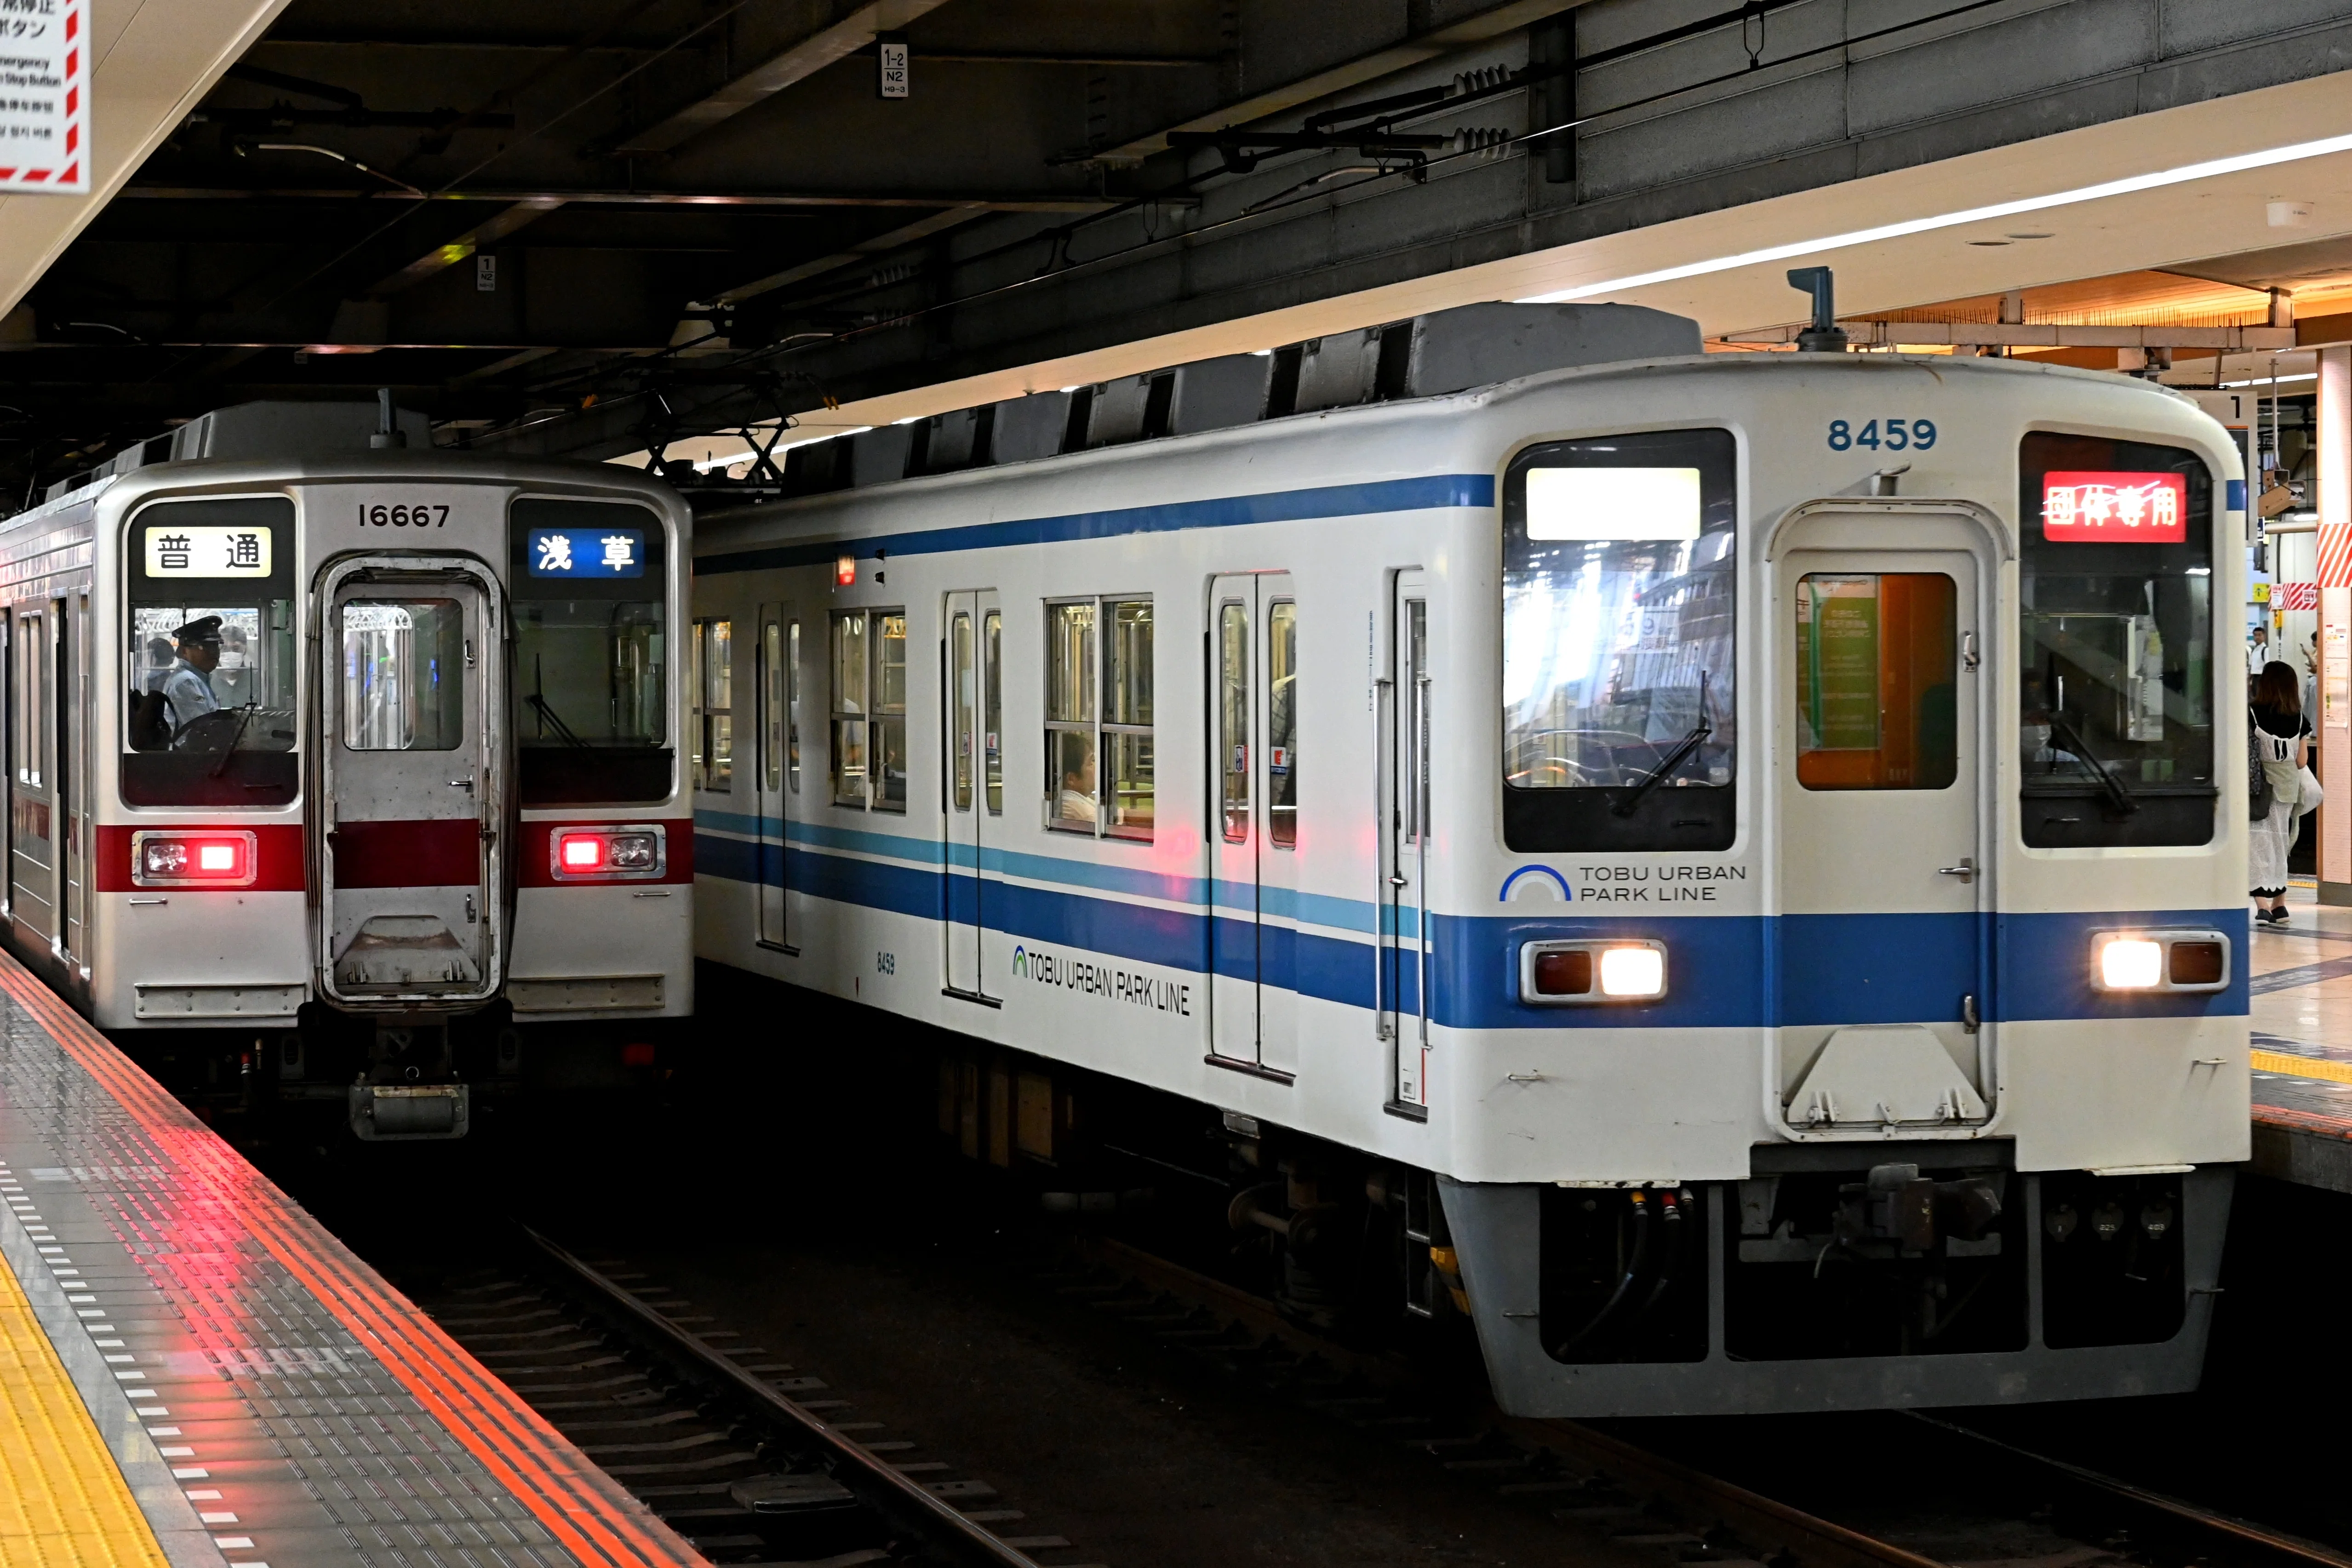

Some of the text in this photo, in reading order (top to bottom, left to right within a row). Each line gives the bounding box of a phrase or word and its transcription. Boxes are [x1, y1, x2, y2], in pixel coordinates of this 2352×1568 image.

[885, 48, 904, 66] 1-2
[887, 71, 903, 81] N2
[1827, 419, 1937, 451] 8459
[359, 504, 450, 528] 16667
[158, 533, 261, 569] 普通
[537, 535, 635, 571] 浅草
[1580, 866, 1746, 881] TOBU URBAN
[1581, 887, 1717, 901] PARK LINE
[877, 951, 894, 975] 8459
[1029, 952, 1190, 1016] TOBU URBAN PARK LINE
